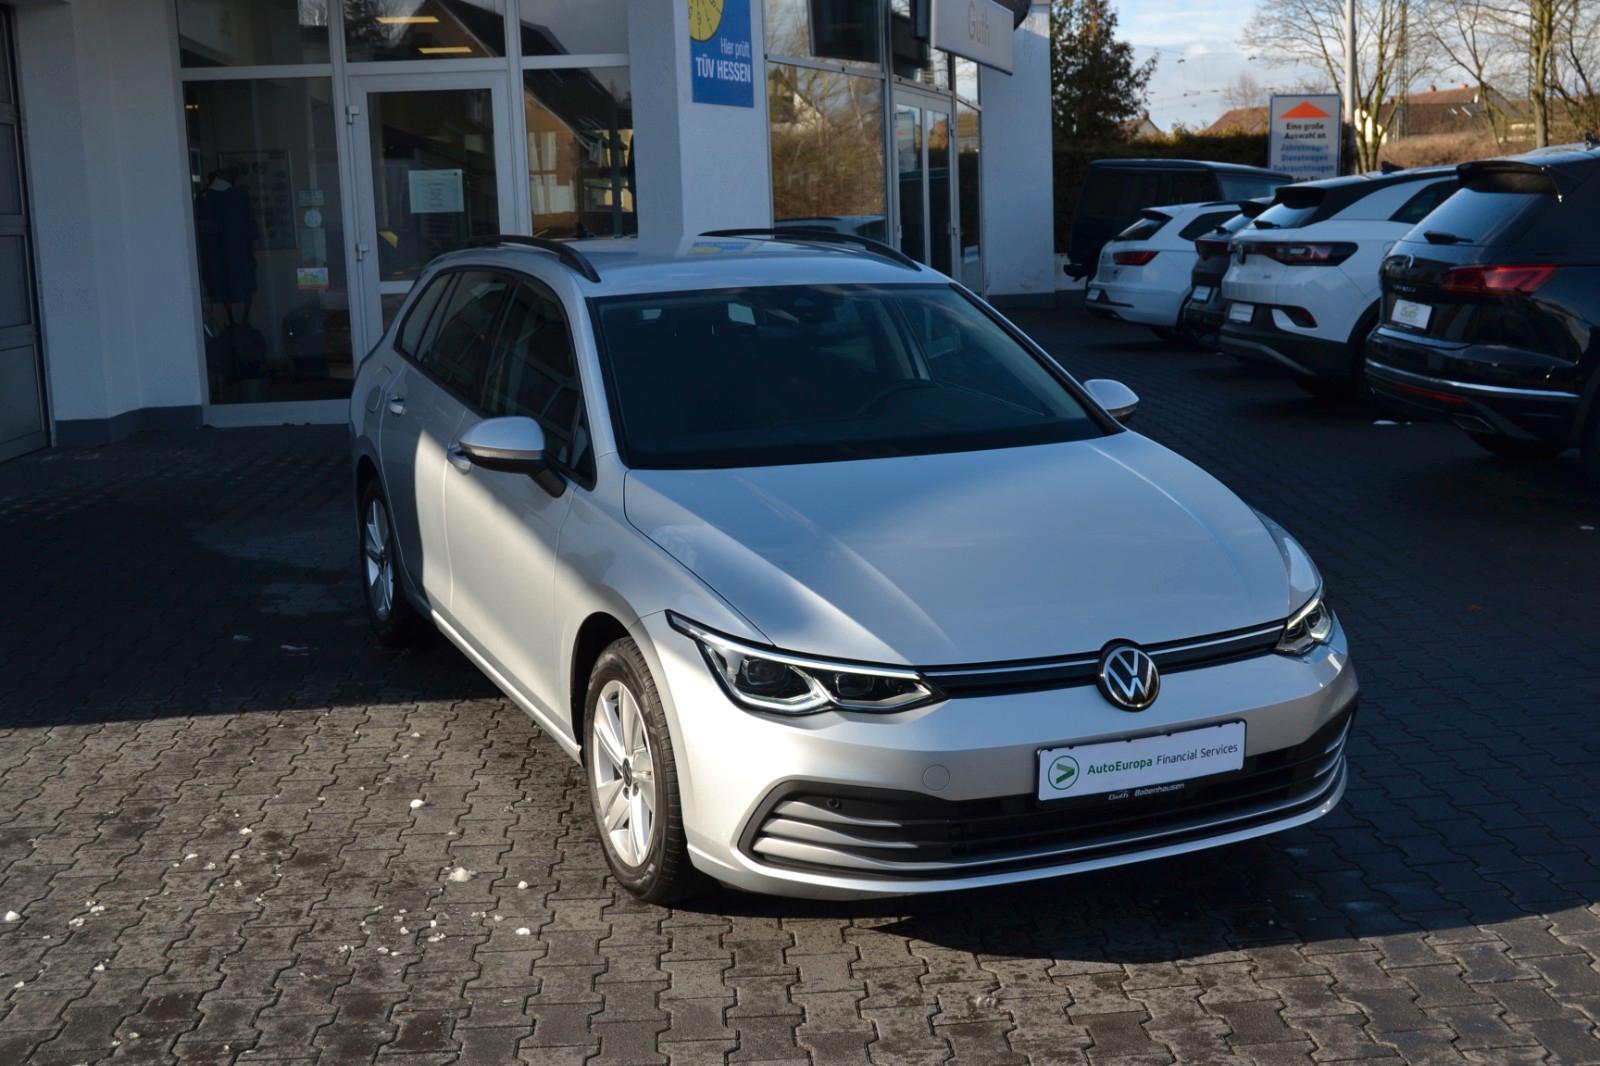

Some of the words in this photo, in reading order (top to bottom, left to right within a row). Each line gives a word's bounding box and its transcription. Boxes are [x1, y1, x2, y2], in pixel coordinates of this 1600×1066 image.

[720, 36, 734, 55] Hier
[735, 41, 751, 59] prüft
[695, 53, 715, 79] TÜV
[717, 60, 751, 83] HESSEN
[1284, 132, 1316, 140] Auswahl
[1286, 122, 1302, 130] Eine
[1303, 122, 1325, 131] große
[1087, 758, 1153, 776] AutoEuropa
[1156, 750, 1198, 766] Financial
[1200, 743, 1239, 759] Services
